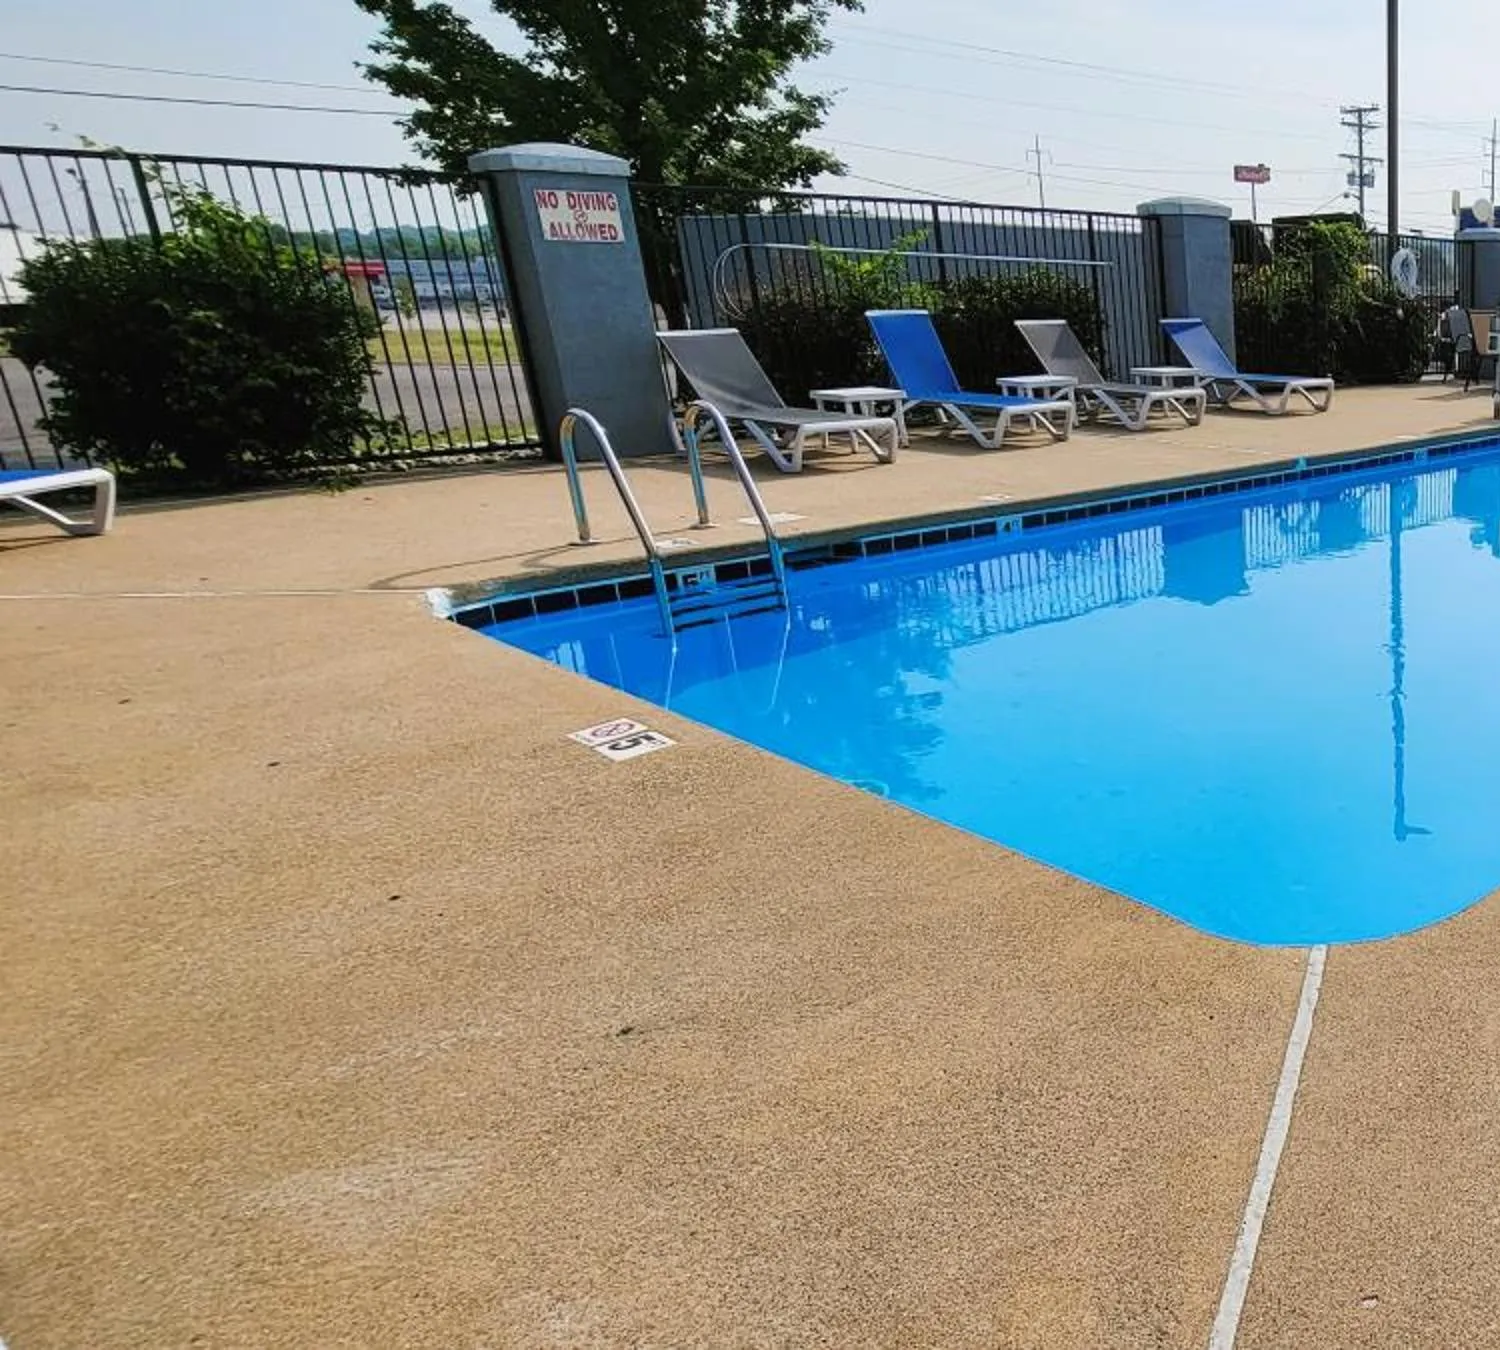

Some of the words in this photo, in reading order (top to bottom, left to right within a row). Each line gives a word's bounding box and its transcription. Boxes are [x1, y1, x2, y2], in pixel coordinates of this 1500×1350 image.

[536, 191, 559, 209] NO
[566, 191, 617, 212] DIVING
[549, 221, 619, 241] ALLOWED
